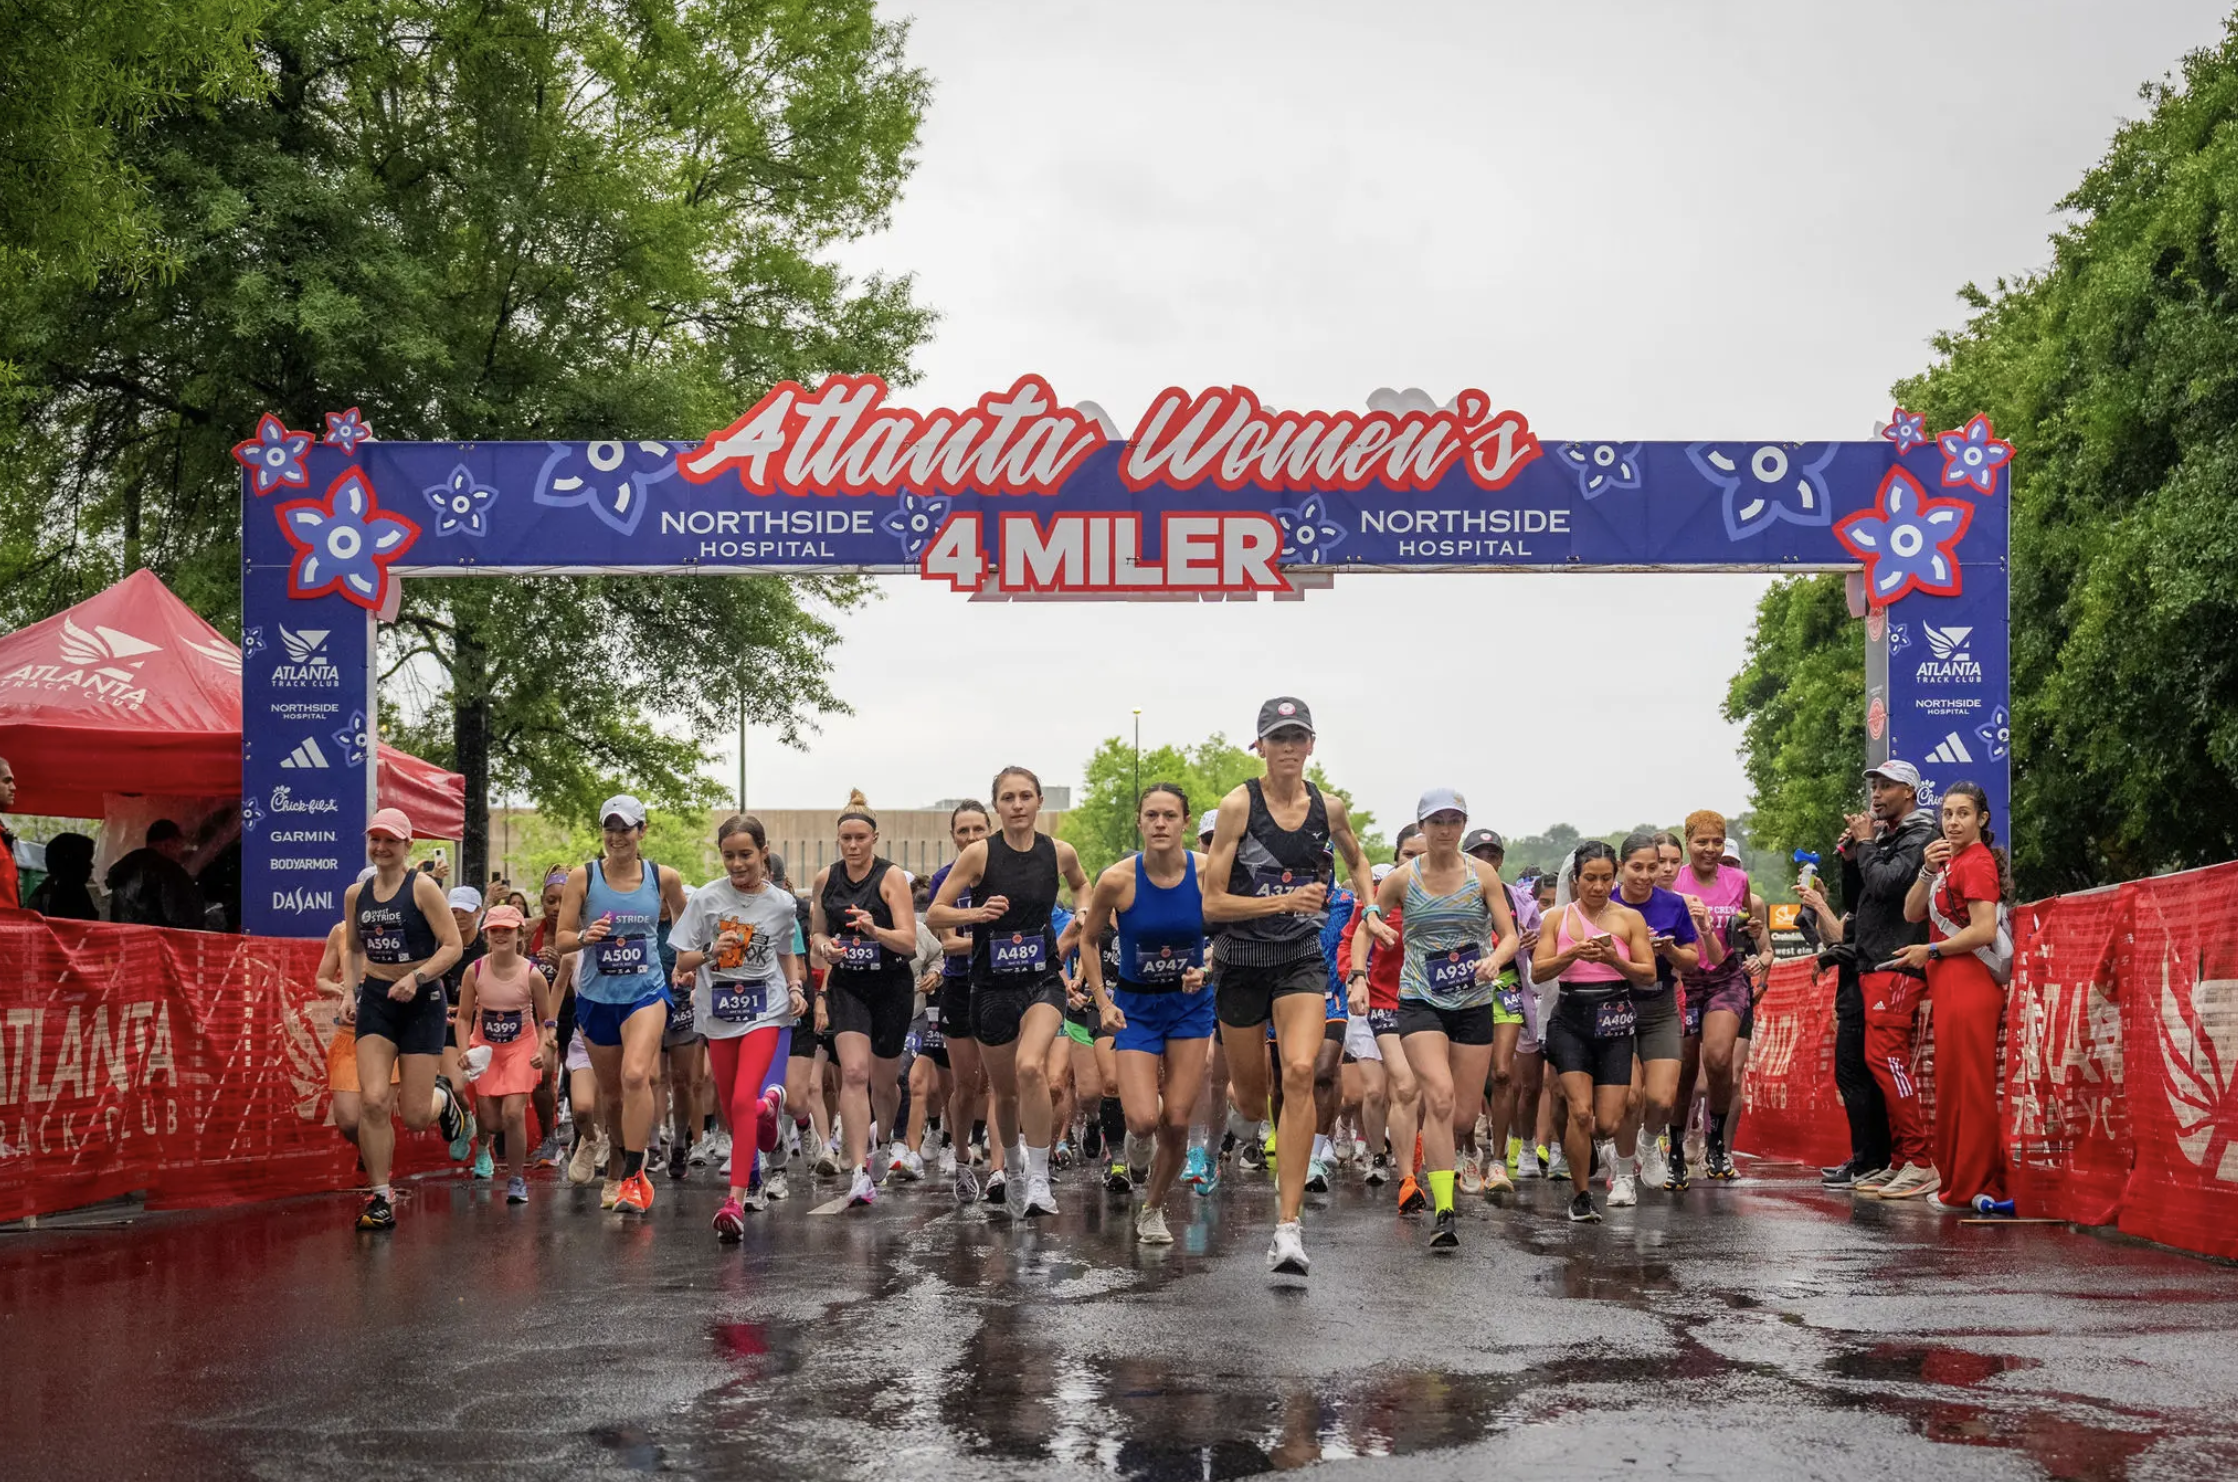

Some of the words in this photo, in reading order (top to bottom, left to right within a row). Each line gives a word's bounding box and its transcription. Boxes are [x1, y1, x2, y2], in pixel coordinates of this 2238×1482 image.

[686, 382, 1097, 488] Atlanta
[1126, 387, 1531, 482] Women's
[661, 510, 874, 535] NORTHSIDE
[1360, 509, 1571, 534] NORTHSIDE
[700, 541, 835, 557] HOSPITAL
[927, 516, 983, 587] 4
[1005, 516, 1282, 587] MILER
[1399, 540, 1532, 556] HOSPITAL
[271, 665, 339, 680] ATLANTA
[1916, 661, 1982, 676] ATLANTA
[3, 663, 147, 705] ATLANTA
[83, 691, 140, 711] CLUB
[270, 703, 339, 713] NORTHSIDE
[1915, 699, 1982, 708] NORTHSIDE
[270, 788, 338, 814] Chick-fil-A
[270, 831, 336, 842] GARMIN
[270, 859, 338, 870] BODYARMOR
[273, 886, 333, 916] DASANI
[370, 912, 401, 922] STRIDE
[615, 914, 650, 924] STRIDE
[367, 938, 400, 950] A596
[602, 948, 642, 963] A500
[996, 944, 1039, 961] A489
[1143, 958, 1188, 973] A947
[1435, 959, 1476, 982] A939
[718, 995, 758, 1010] A391
[1602, 1012, 1634, 1027] A406
[485, 1022, 517, 1033] A399
